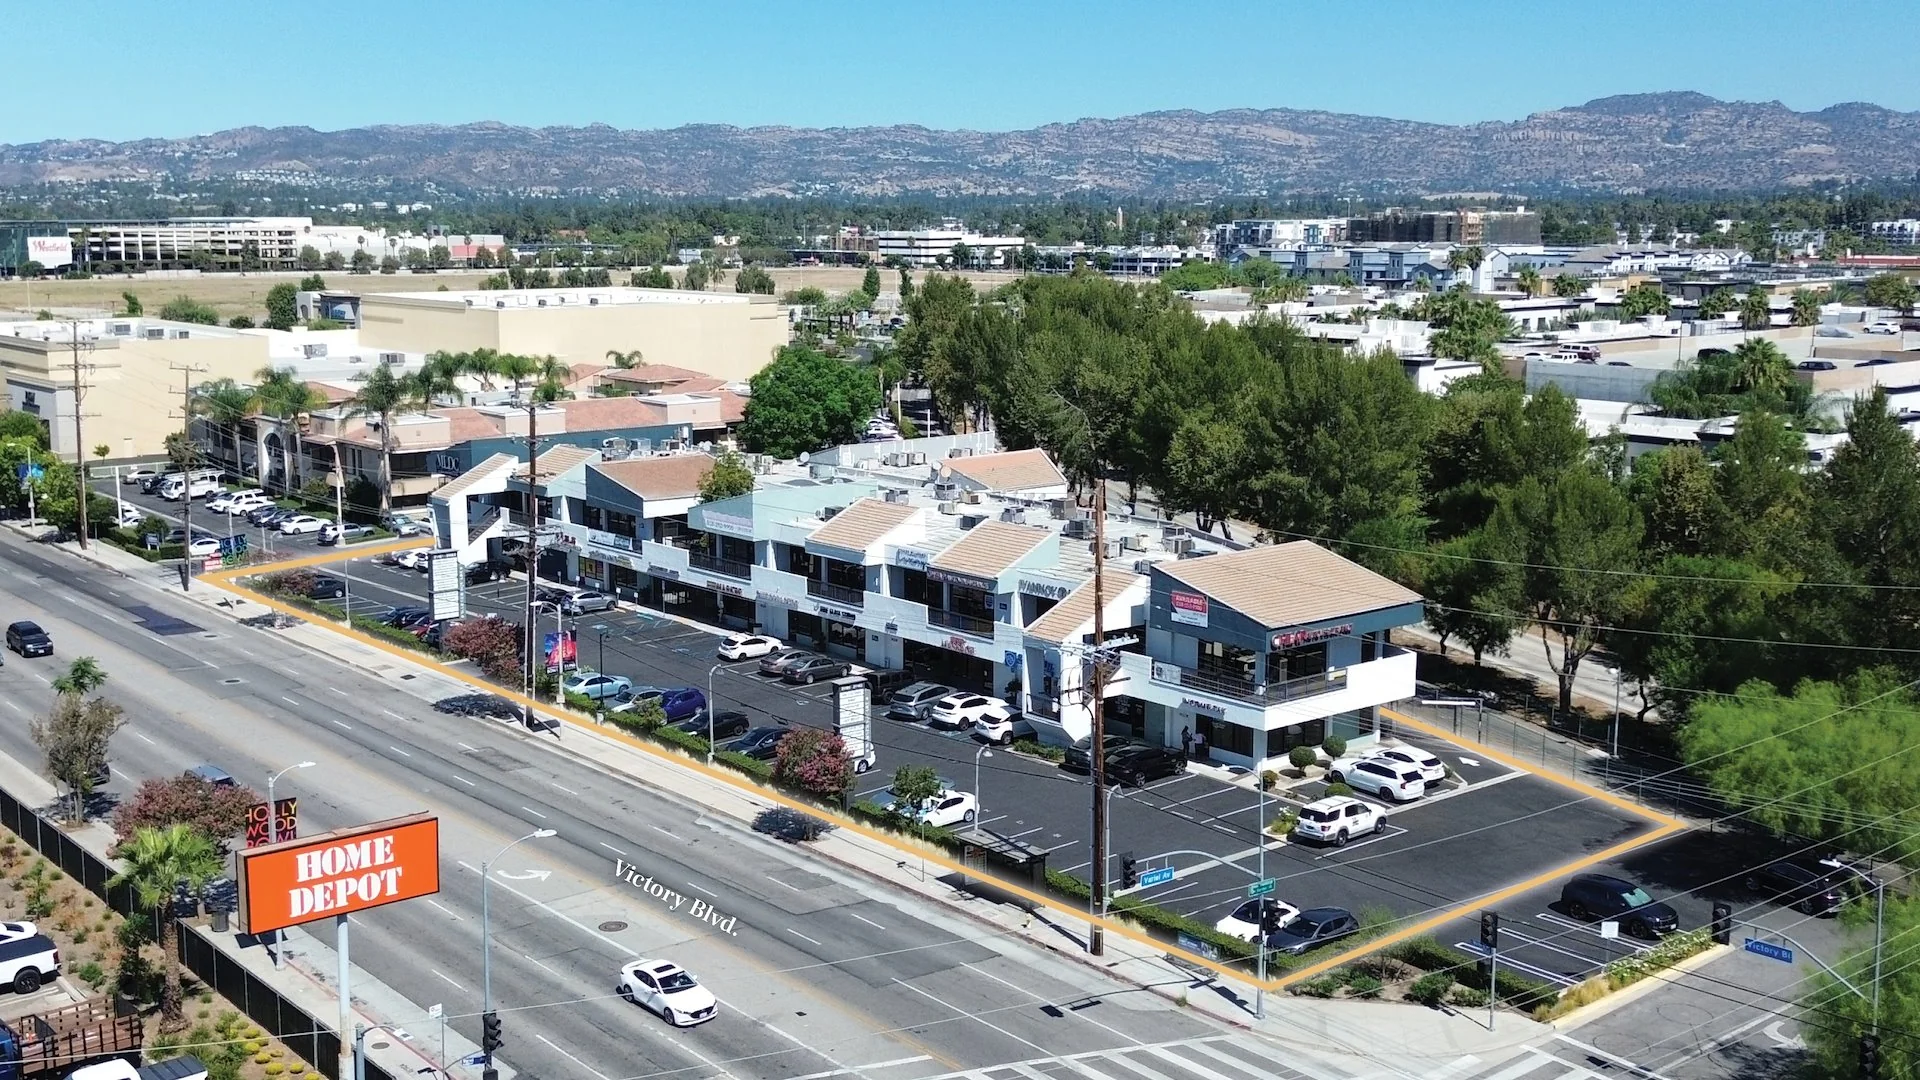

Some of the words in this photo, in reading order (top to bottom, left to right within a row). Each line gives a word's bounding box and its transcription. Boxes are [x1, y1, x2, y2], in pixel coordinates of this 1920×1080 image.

[33, 240, 67, 252] Westfield
[247, 816, 297, 837] WOOD
[296, 835, 394, 883] HOME
[289, 867, 403, 918] DEPOT
[1747, 941, 1779, 957] Victory
